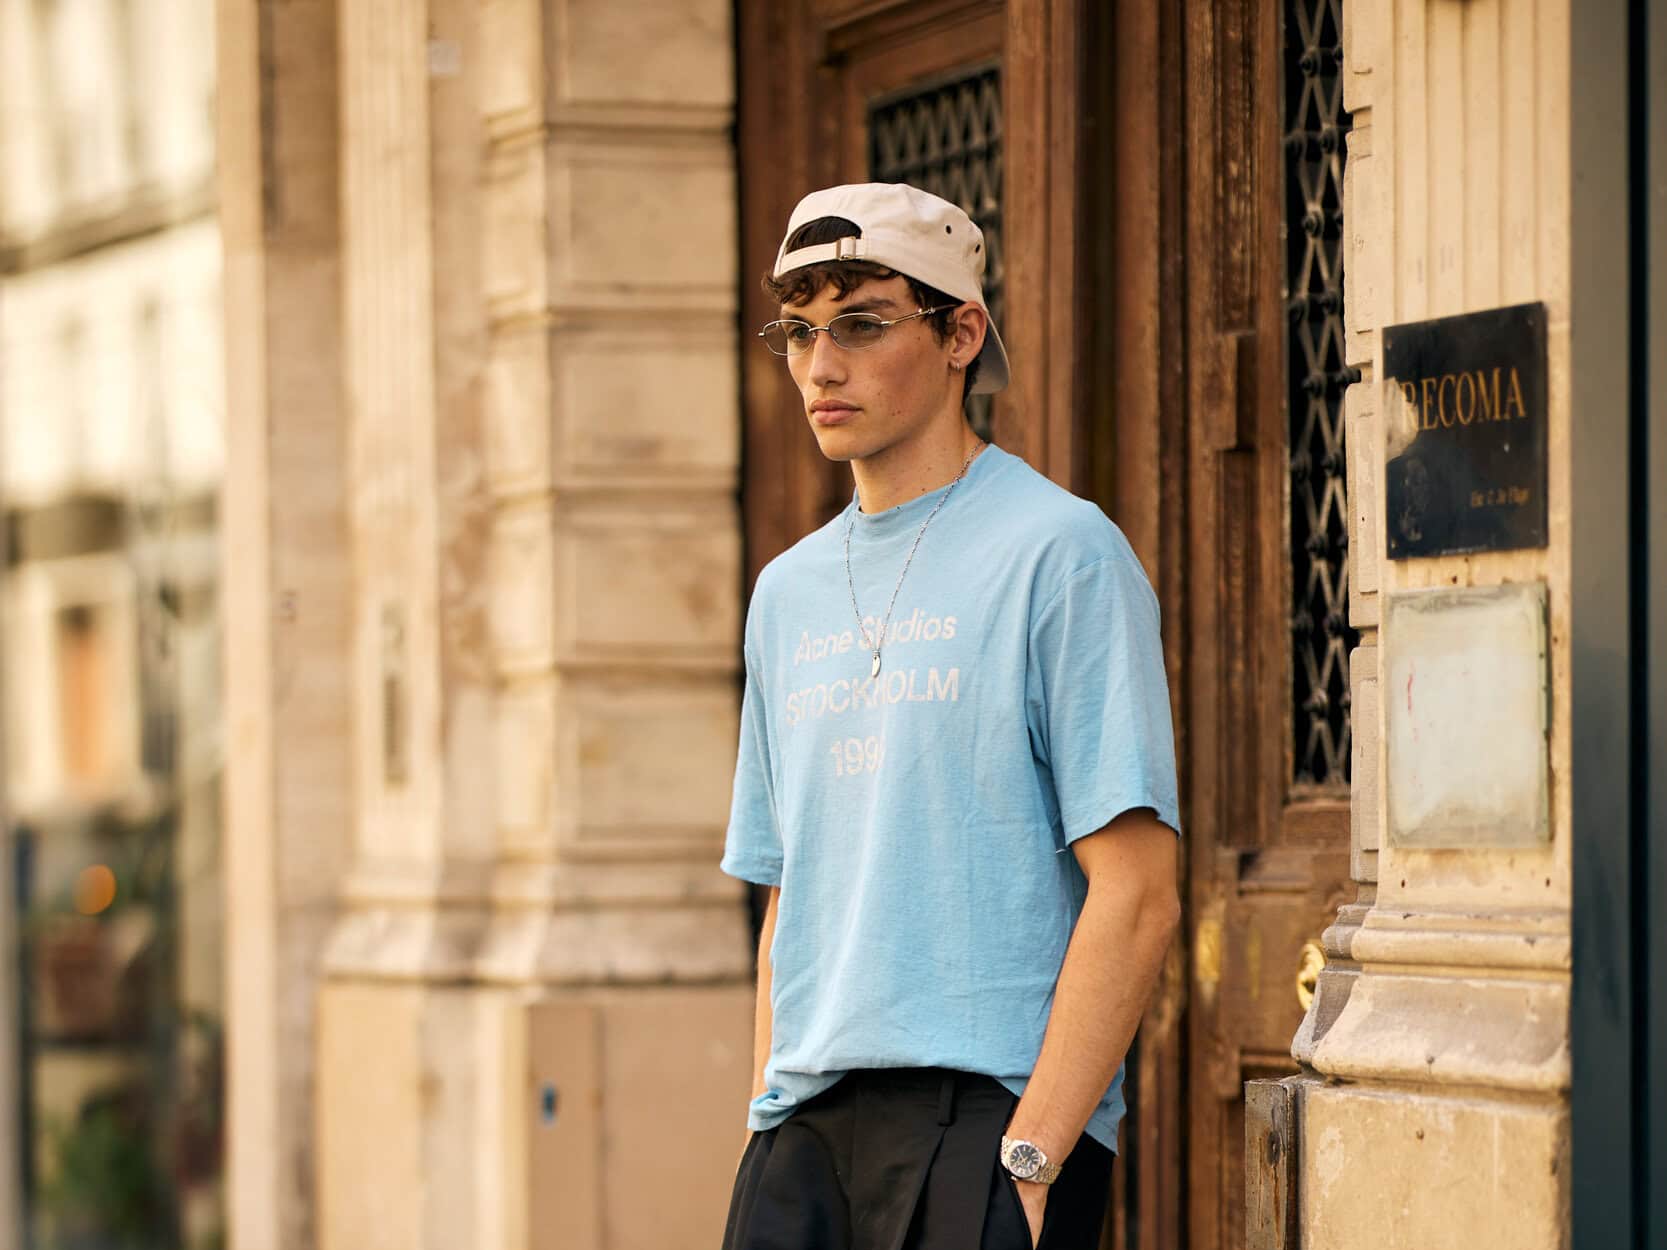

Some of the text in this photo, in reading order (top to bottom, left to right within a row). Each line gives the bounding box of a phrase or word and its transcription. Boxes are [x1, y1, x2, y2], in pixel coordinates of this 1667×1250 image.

[794, 607, 958, 665] Acne Studios
[786, 667, 960, 726] STOCKHOLM
[831, 736, 885, 776] 199
